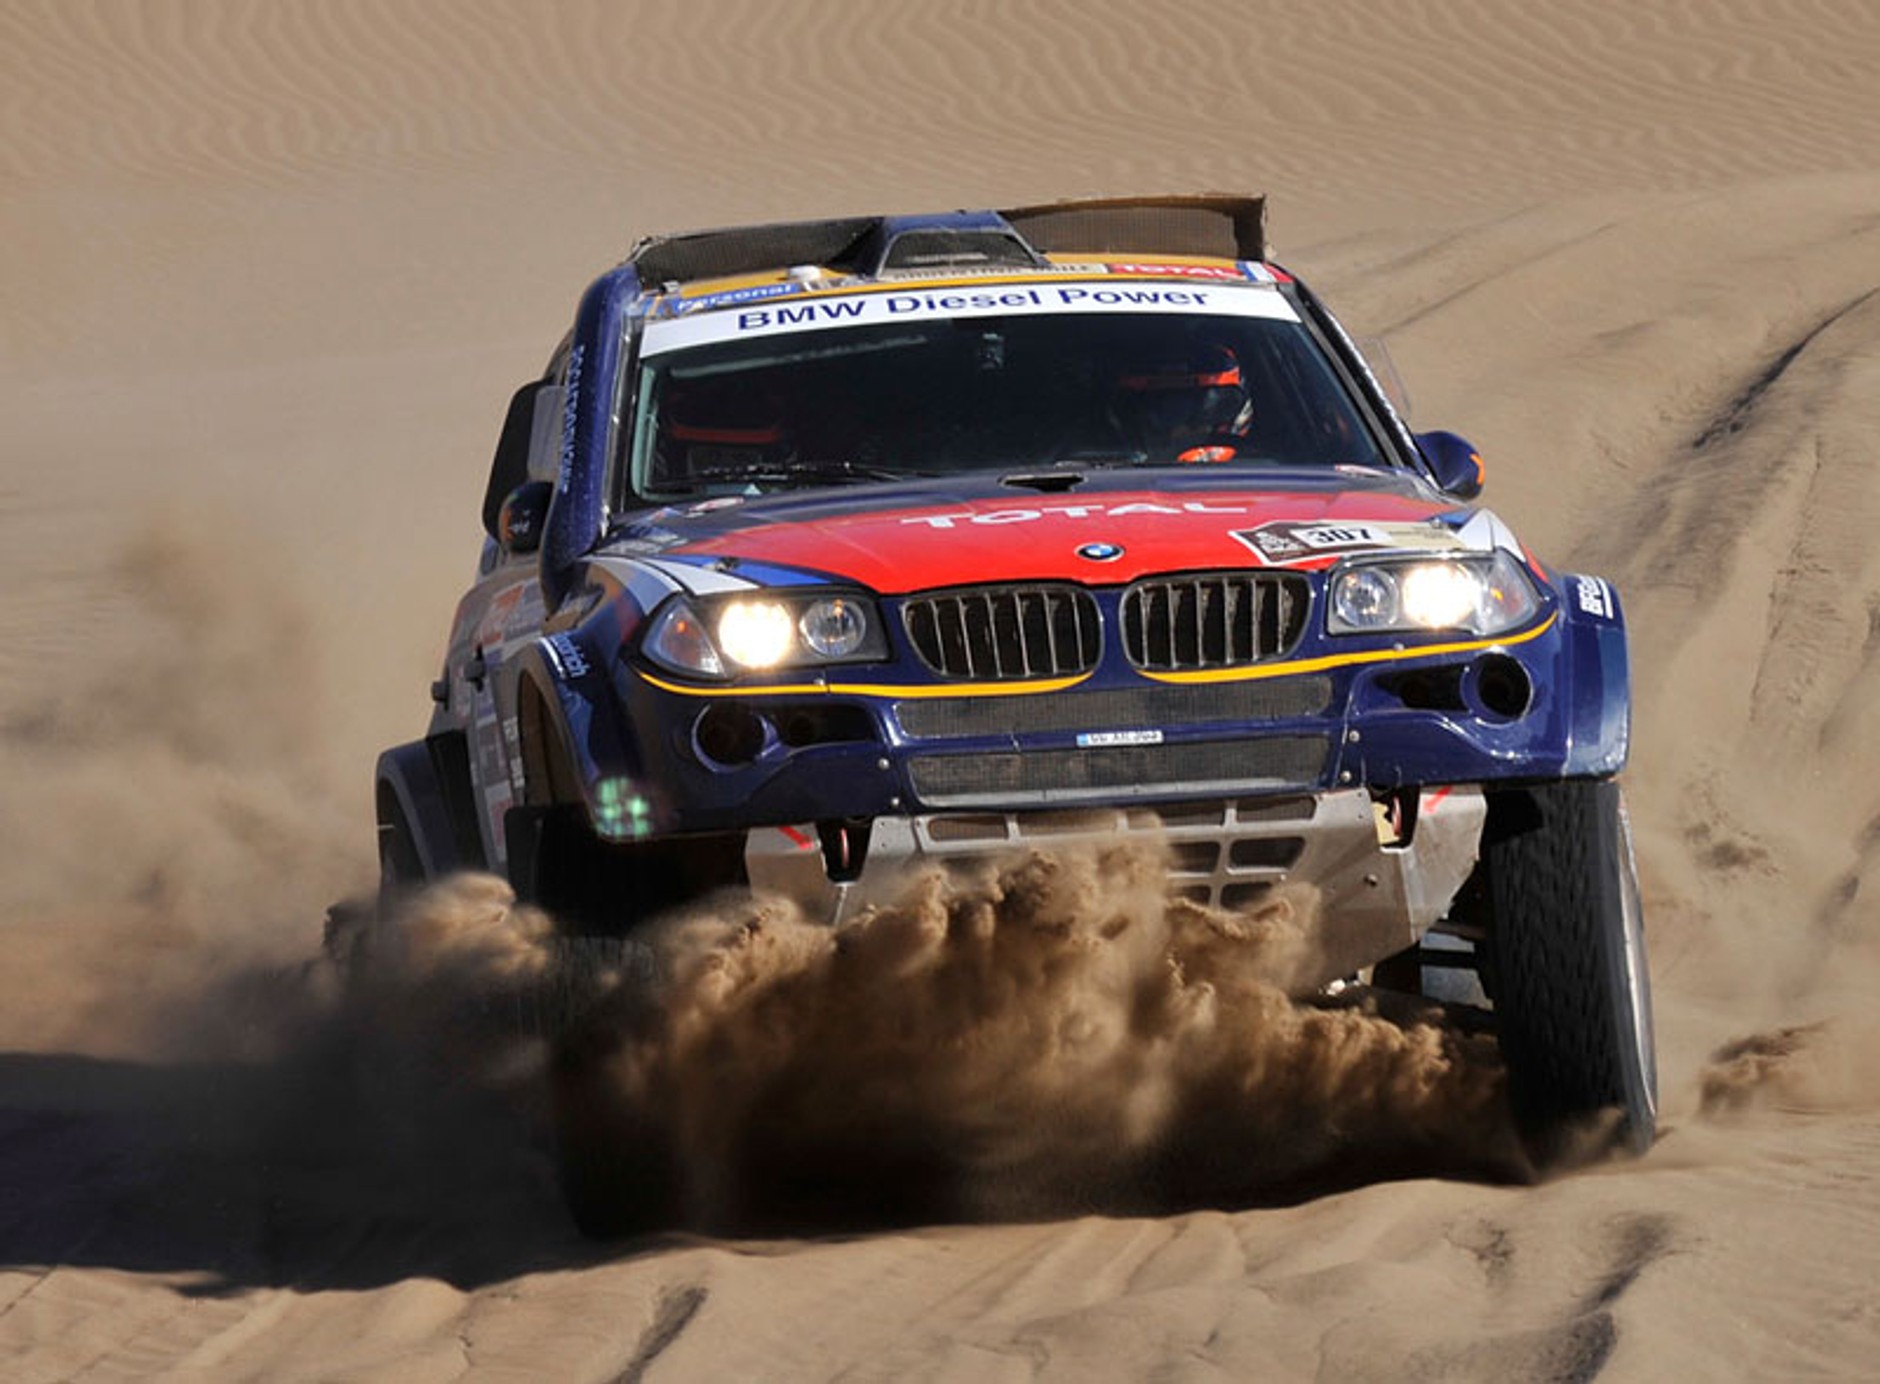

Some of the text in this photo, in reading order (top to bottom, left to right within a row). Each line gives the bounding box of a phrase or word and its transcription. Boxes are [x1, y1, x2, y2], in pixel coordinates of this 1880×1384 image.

[1116, 264, 1239, 278] TOTAL
[738, 288, 1209, 331] BMW Diesel Power
[901, 502, 1247, 528] TOTAL
[1307, 526, 1372, 544] 307
